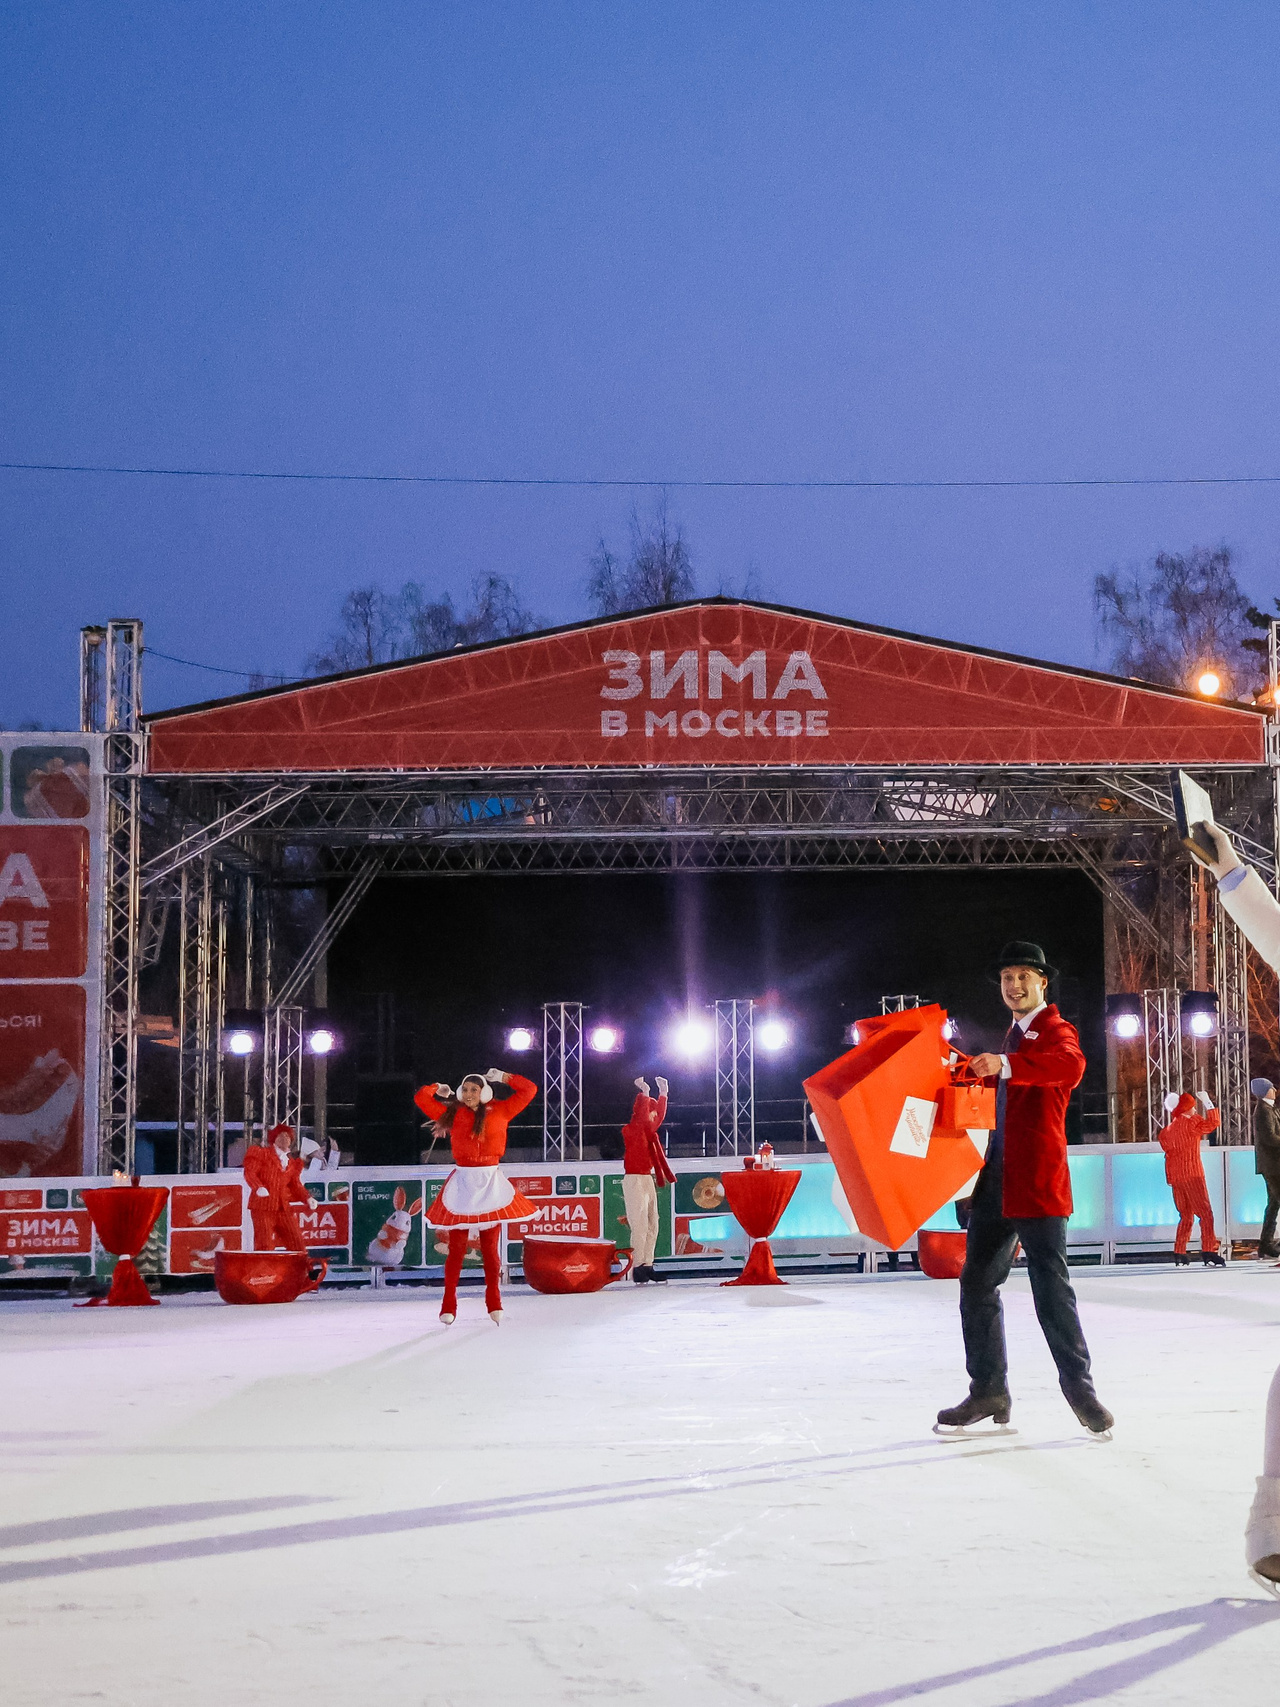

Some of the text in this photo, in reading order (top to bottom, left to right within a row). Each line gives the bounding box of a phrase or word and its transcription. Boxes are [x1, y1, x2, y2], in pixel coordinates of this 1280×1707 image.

[600, 649, 829, 700] ЗИМА
[601, 710, 829, 737] В МОСКВЕ
[536, 1204, 588, 1221] ИМА
[8, 1218, 79, 1236] ЗИМА
[520, 1222, 588, 1233] В МОСКВЕ
[21, 1237, 79, 1248] МОСКВЕ
